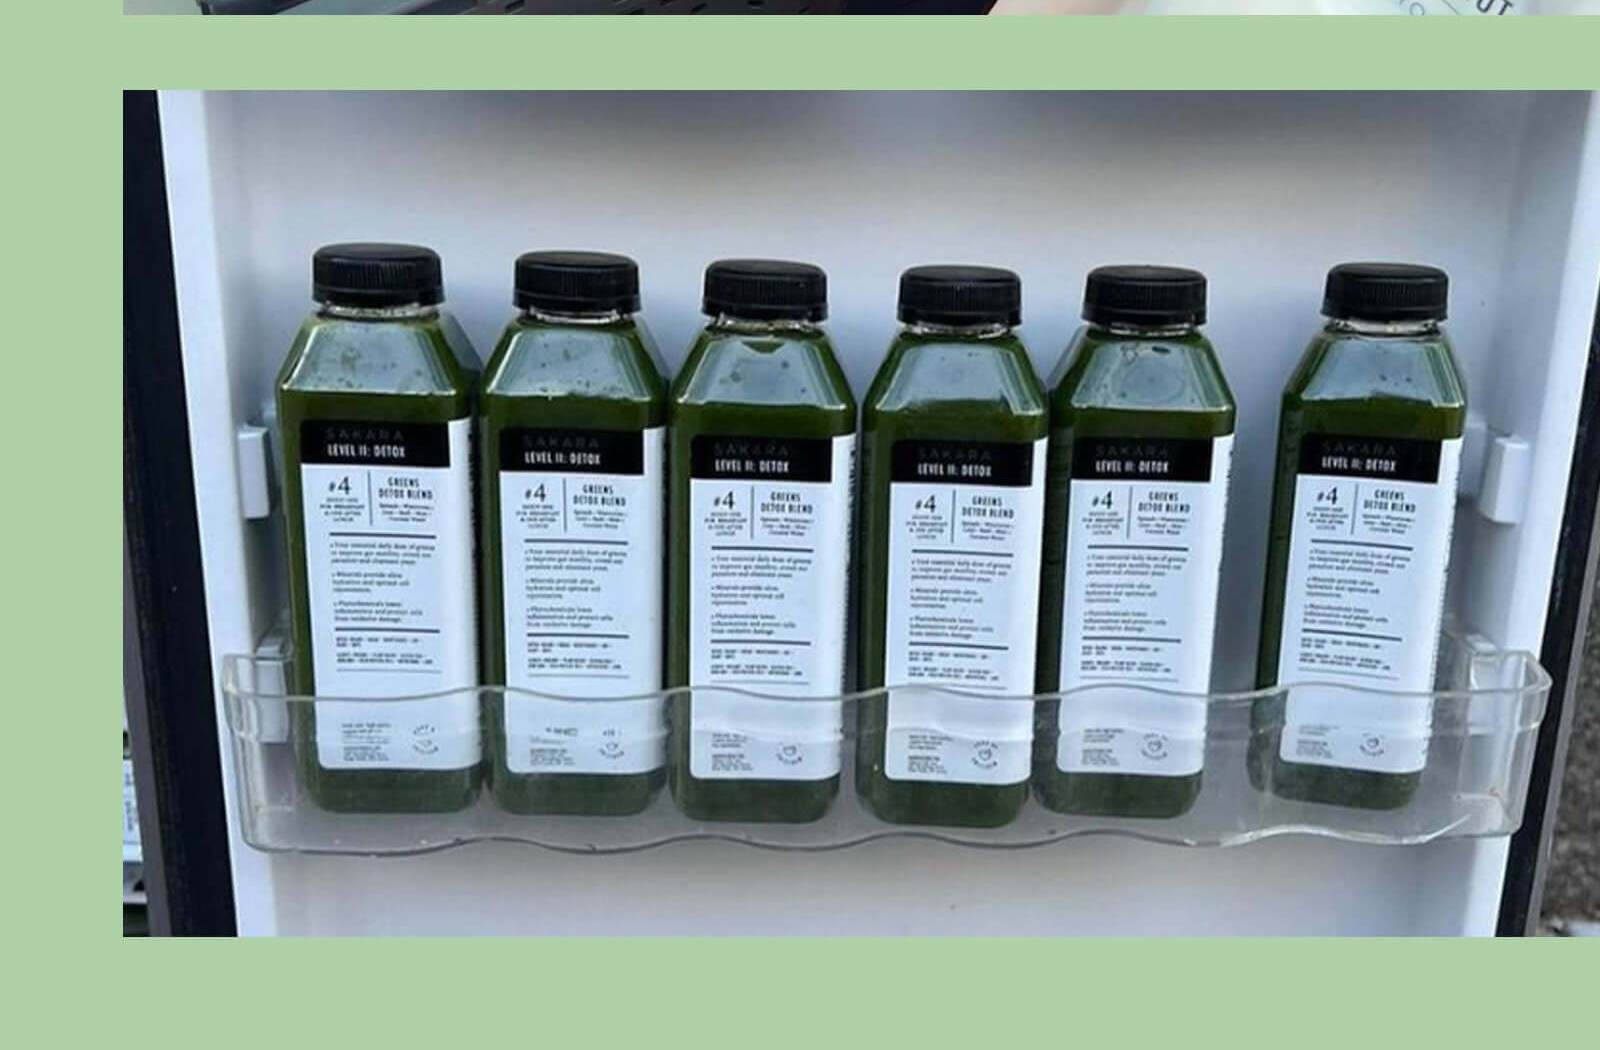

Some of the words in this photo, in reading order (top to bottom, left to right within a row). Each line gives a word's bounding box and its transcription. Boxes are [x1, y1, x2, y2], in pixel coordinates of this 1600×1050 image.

[327, 443, 355, 457] LEVEL
[374, 445, 406, 458] DETOX
[524, 451, 552, 464] LEVEL
[569, 452, 601, 465] DETOX
[715, 459, 742, 472] LEVEL
[759, 460, 789, 473] DETOX
[917, 462, 945, 476] LEVEL
[961, 464, 992, 477] DETOX
[1095, 459, 1122, 473] LEVEL
[1138, 460, 1169, 473] DETOX
[1321, 456, 1348, 469] LEVEL
[1365, 458, 1397, 472] DETOX
[328, 476, 351, 495] #4
[524, 483, 546, 502] #4
[713, 491, 735, 510] #4
[915, 494, 936, 513] #4
[1092, 490, 1113, 510] #4
[1317, 486, 1338, 505] #4
